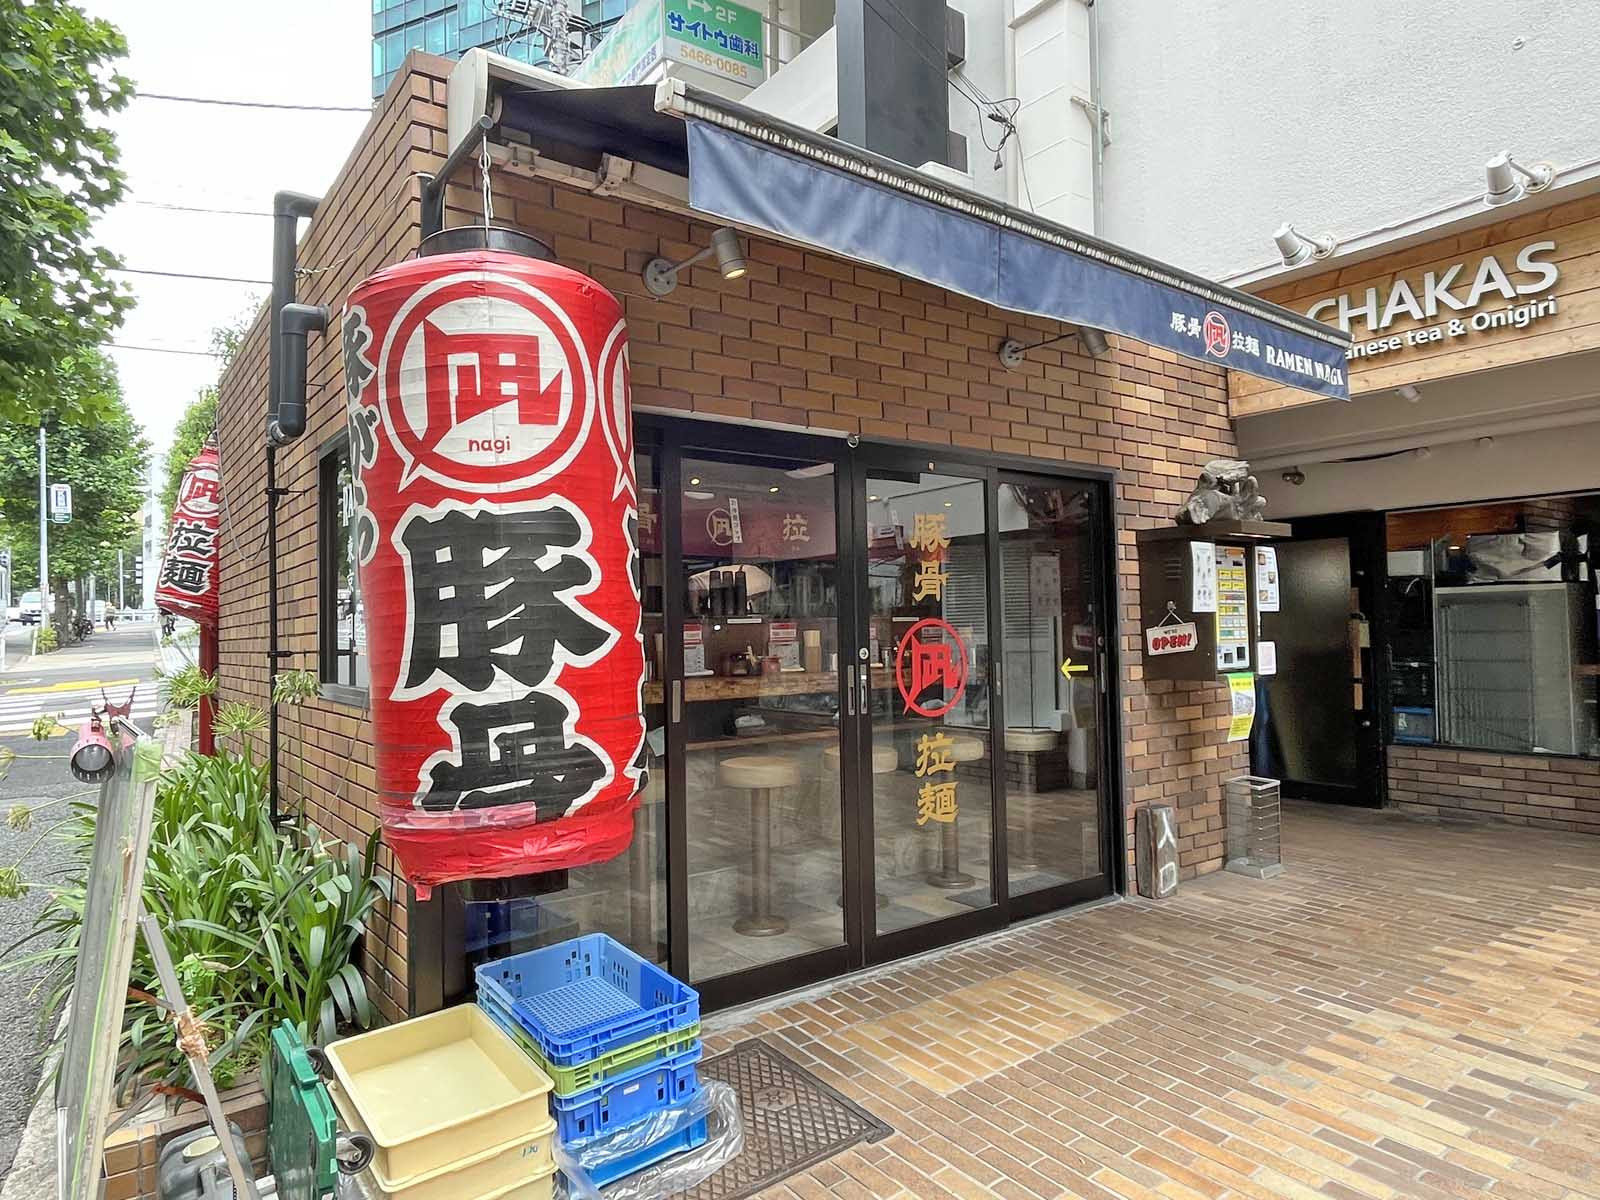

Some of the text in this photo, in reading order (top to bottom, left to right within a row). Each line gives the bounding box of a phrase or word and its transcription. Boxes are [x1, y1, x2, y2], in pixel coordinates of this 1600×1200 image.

[666, 11, 760, 60] サイトウ歯科
[715, 6, 736, 24] 2F
[680, 44, 748, 79] 5466-0085
[1406, 326, 1442, 346] tea
[1447, 318, 1467, 337] &
[1471, 295, 1558, 331] Onigiri
[1170, 312, 1202, 339] 豚骨
[1265, 345, 1314, 376] RAMEN
[1314, 361, 1345, 386] NAGI
[468, 435, 511, 454] nagi
[783, 513, 810, 542] 拉
[161, 520, 215, 593] 拉麺
[910, 513, 950, 602] 豚骨
[1151, 633, 1193, 651] OPEN!
[914, 731, 960, 826] 拉麺
